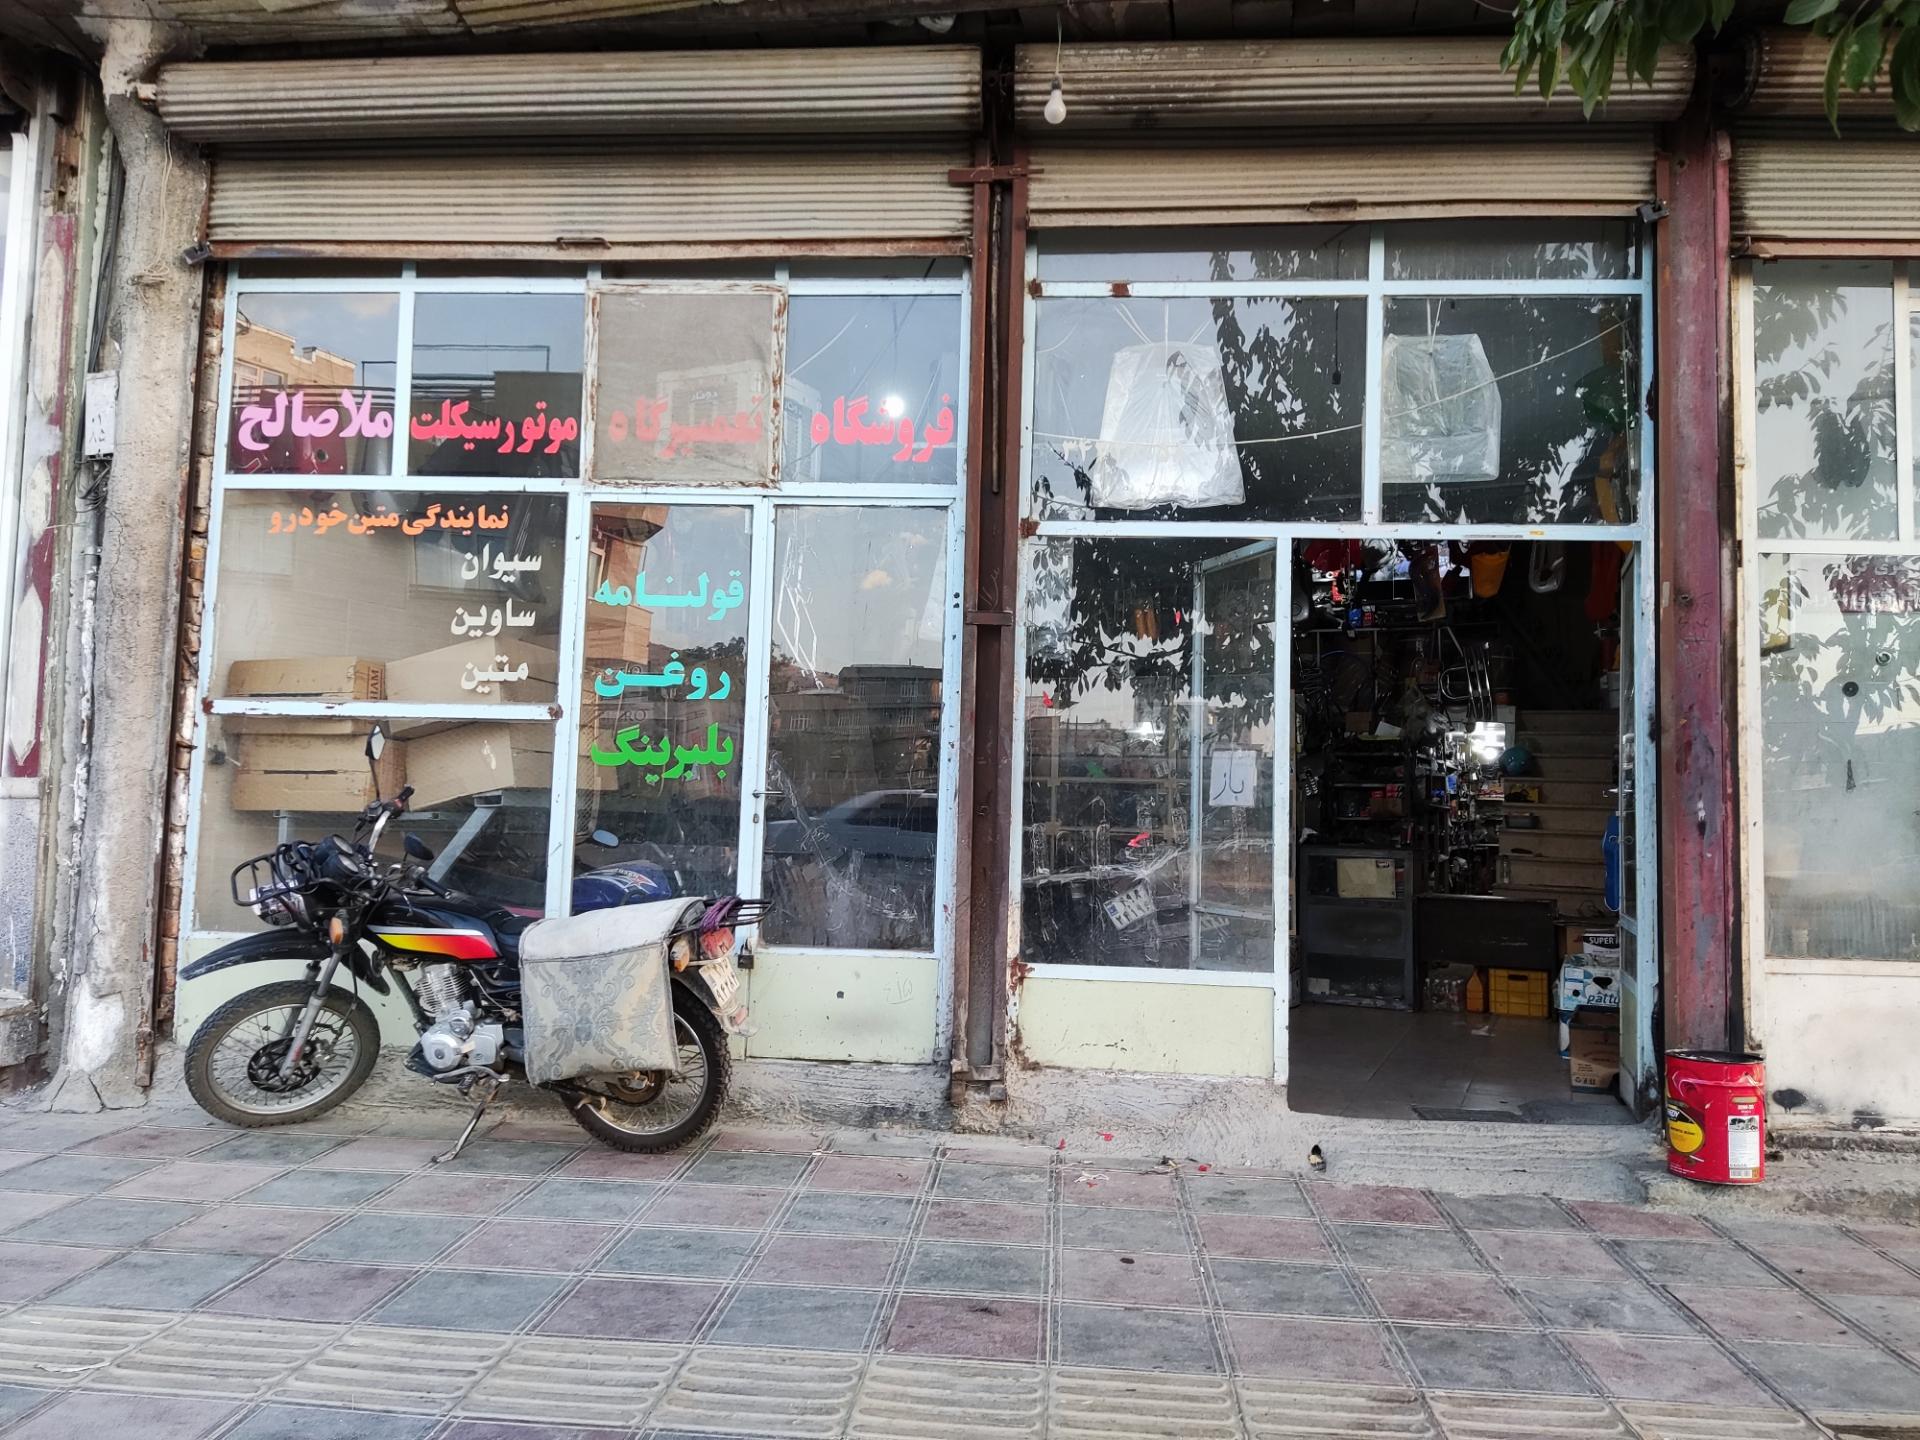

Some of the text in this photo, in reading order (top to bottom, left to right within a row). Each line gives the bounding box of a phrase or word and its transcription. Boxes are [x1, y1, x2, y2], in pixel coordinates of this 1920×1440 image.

[411, 400, 578, 453] موتورسیکلت
[608, 396, 763, 458] تعمیرگاه
[811, 395, 954, 462] فروشگاه
[267, 502, 509, 535] نمایندگی متین خودرو
[461, 543, 542, 582] سیوان
[450, 598, 536, 637] ساوین
[594, 570, 744, 621] قولنامه
[460, 655, 529, 693] متین
[594, 651, 731, 700] روغن
[591, 722, 734, 782] بلبرینگ
[1213, 752, 1245, 801] باز
[1589, 936, 1615, 945] SUPER
